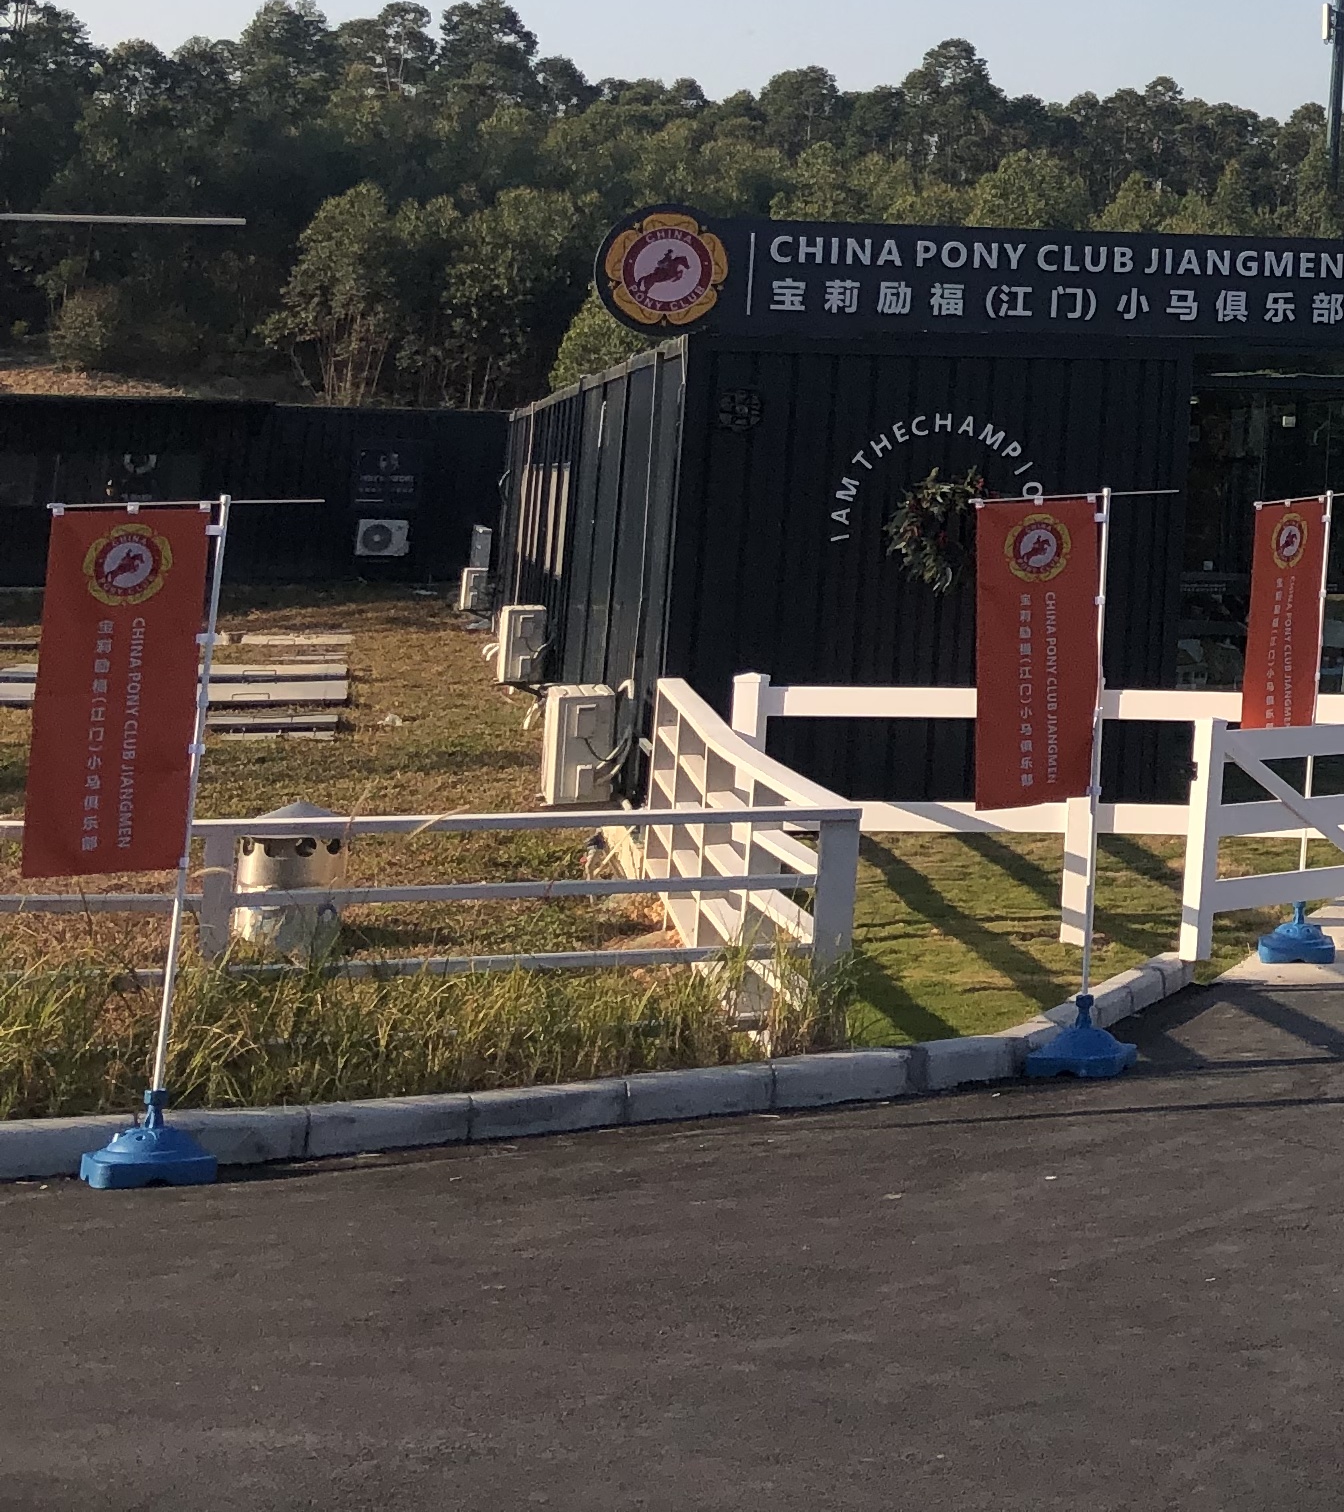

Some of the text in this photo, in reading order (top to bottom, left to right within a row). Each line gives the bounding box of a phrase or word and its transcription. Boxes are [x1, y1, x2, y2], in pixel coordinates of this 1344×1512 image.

[645, 230, 693, 244] CHINA
[769, 235, 1344, 279] CHINA PONY CLUB JIANGMEN
[629, 284, 706, 311] PONY CLUB
[831, 477, 860, 525] AM
[1045, 592, 1058, 784] CHINA PONY CLUB JIANGMEN
[117, 617, 146, 848] CHINA PONY CLUB JIANGMEN
